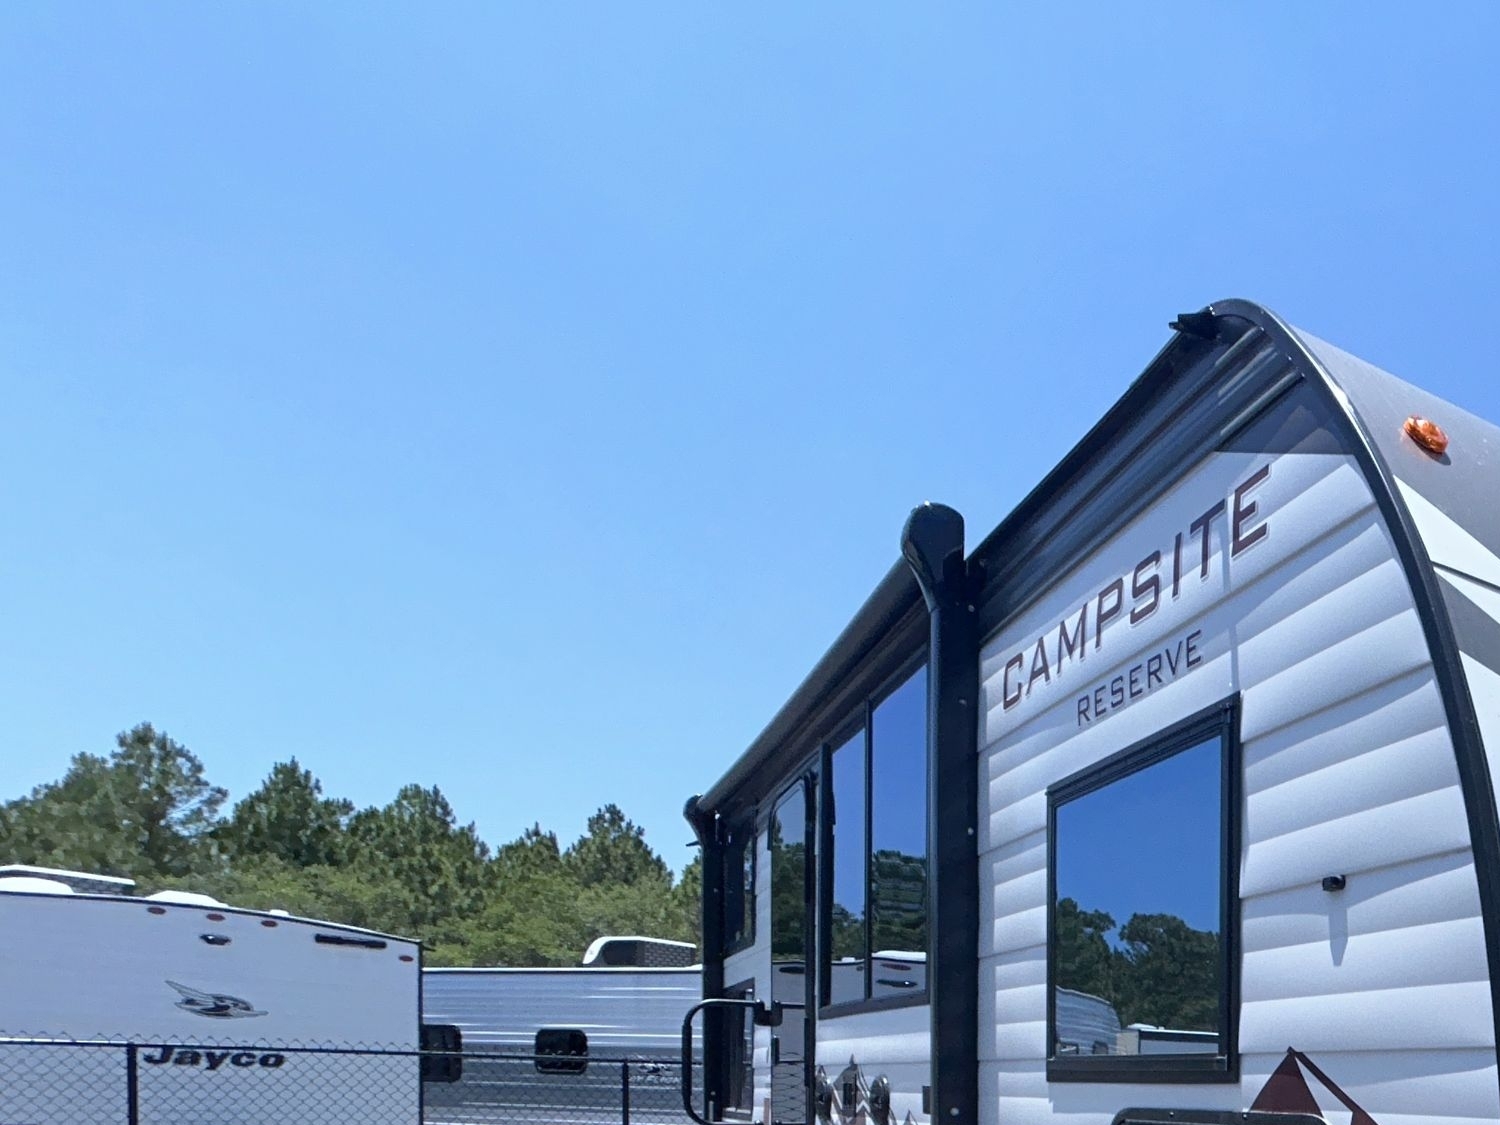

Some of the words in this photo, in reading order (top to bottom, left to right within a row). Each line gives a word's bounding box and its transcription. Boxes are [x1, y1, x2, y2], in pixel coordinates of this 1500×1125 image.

[1002, 463, 1270, 711] CAMPSITE
[1077, 629, 1204, 727] RESERVE
[143, 1046, 286, 1071] Jayco
